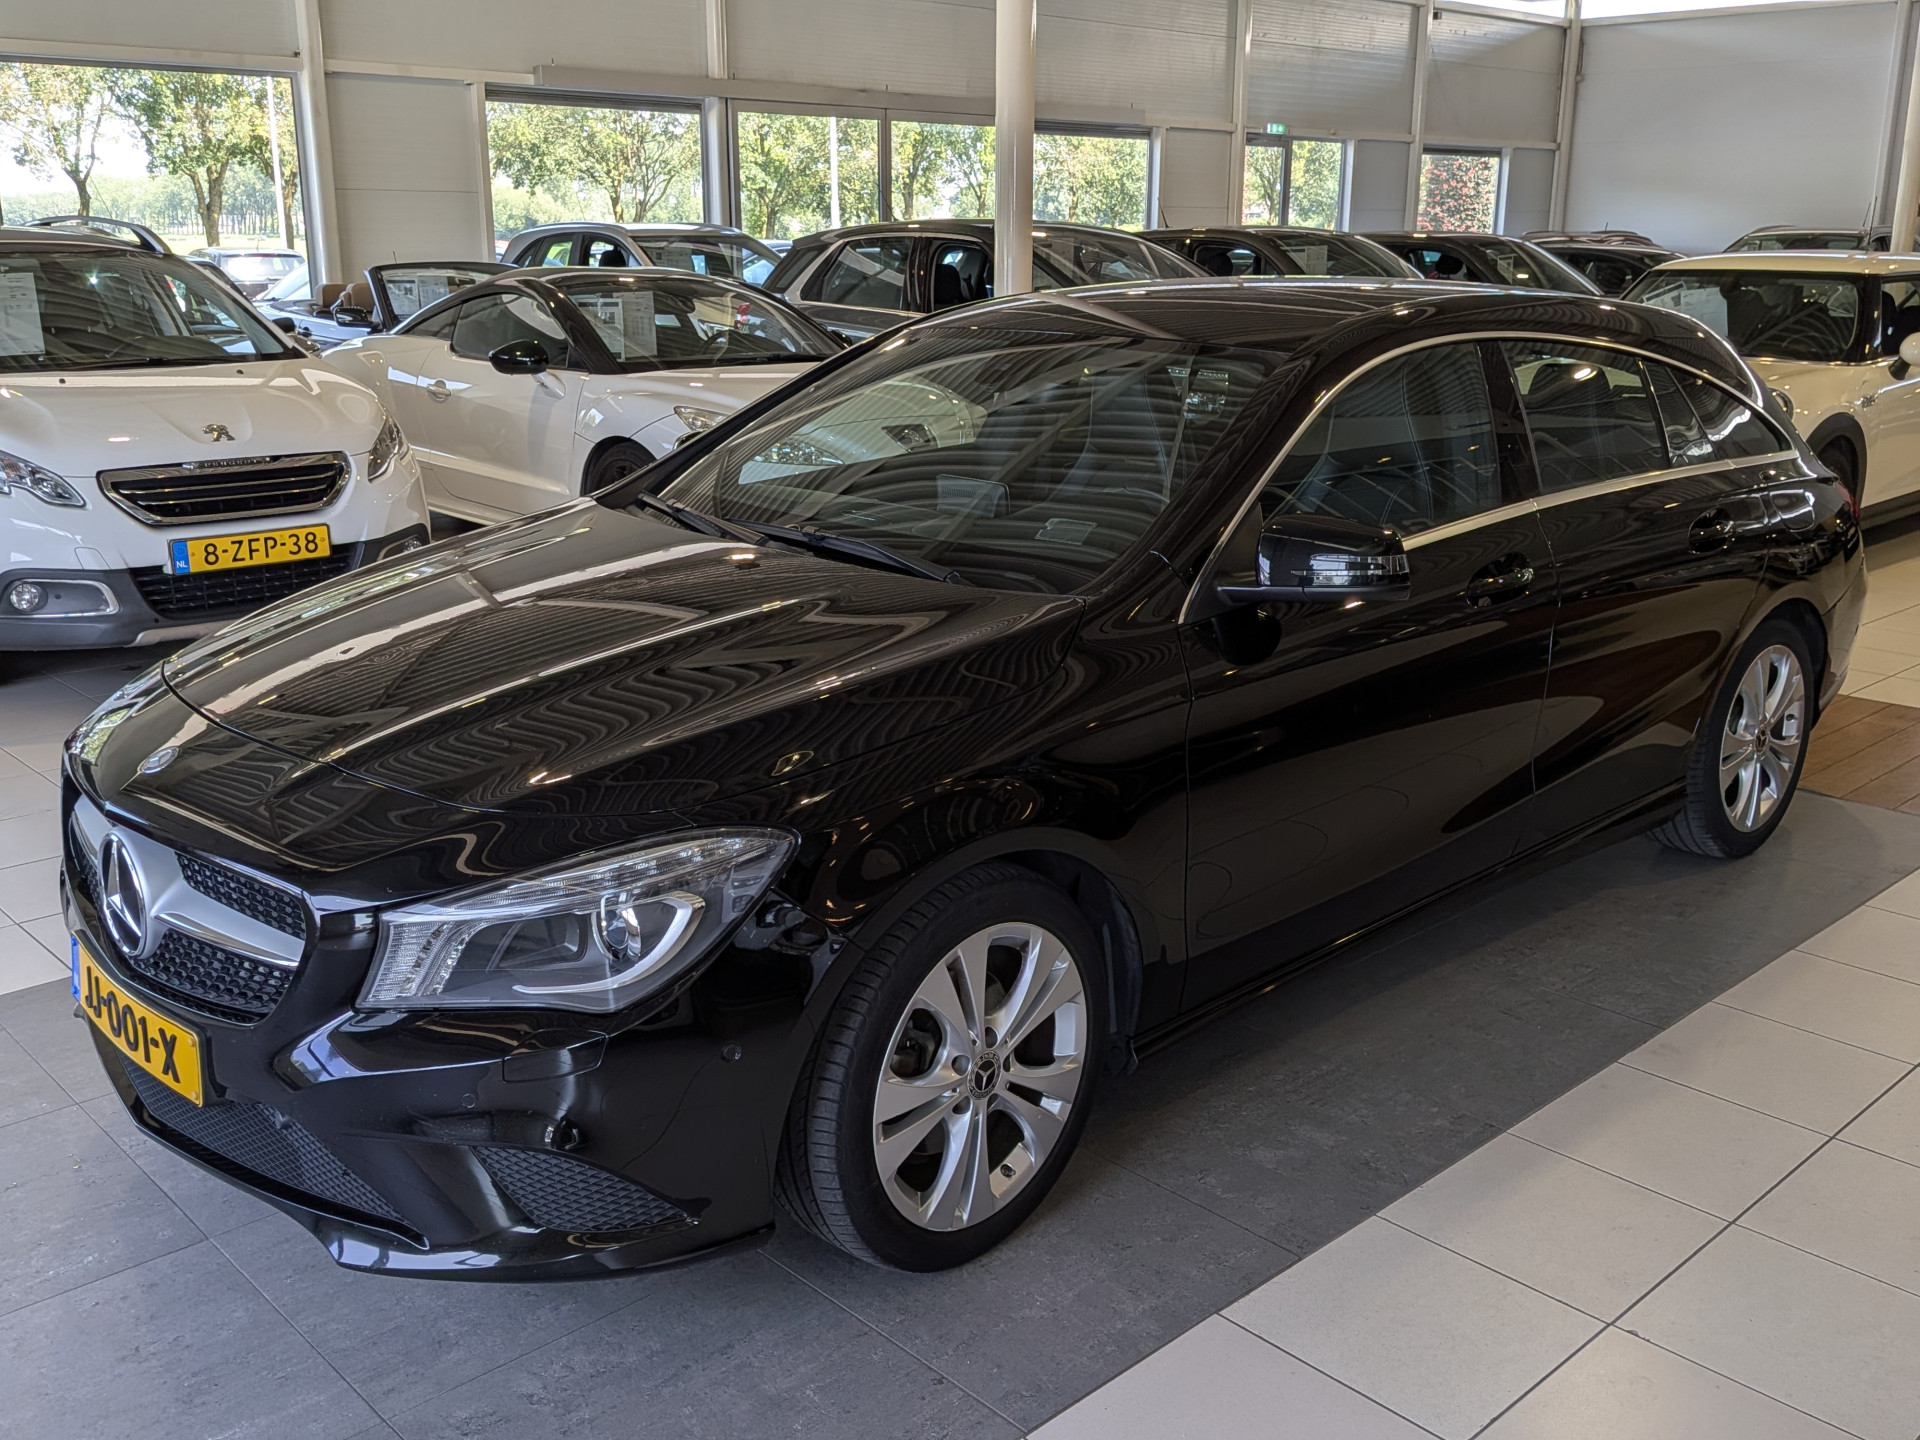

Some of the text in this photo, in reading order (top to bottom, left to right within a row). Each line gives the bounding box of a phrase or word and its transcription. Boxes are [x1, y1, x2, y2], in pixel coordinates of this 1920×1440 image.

[176, 560, 188, 569] NL
[203, 531, 318, 566] 8-ZFP-38
[85, 965, 181, 1084] JJ-001-X
